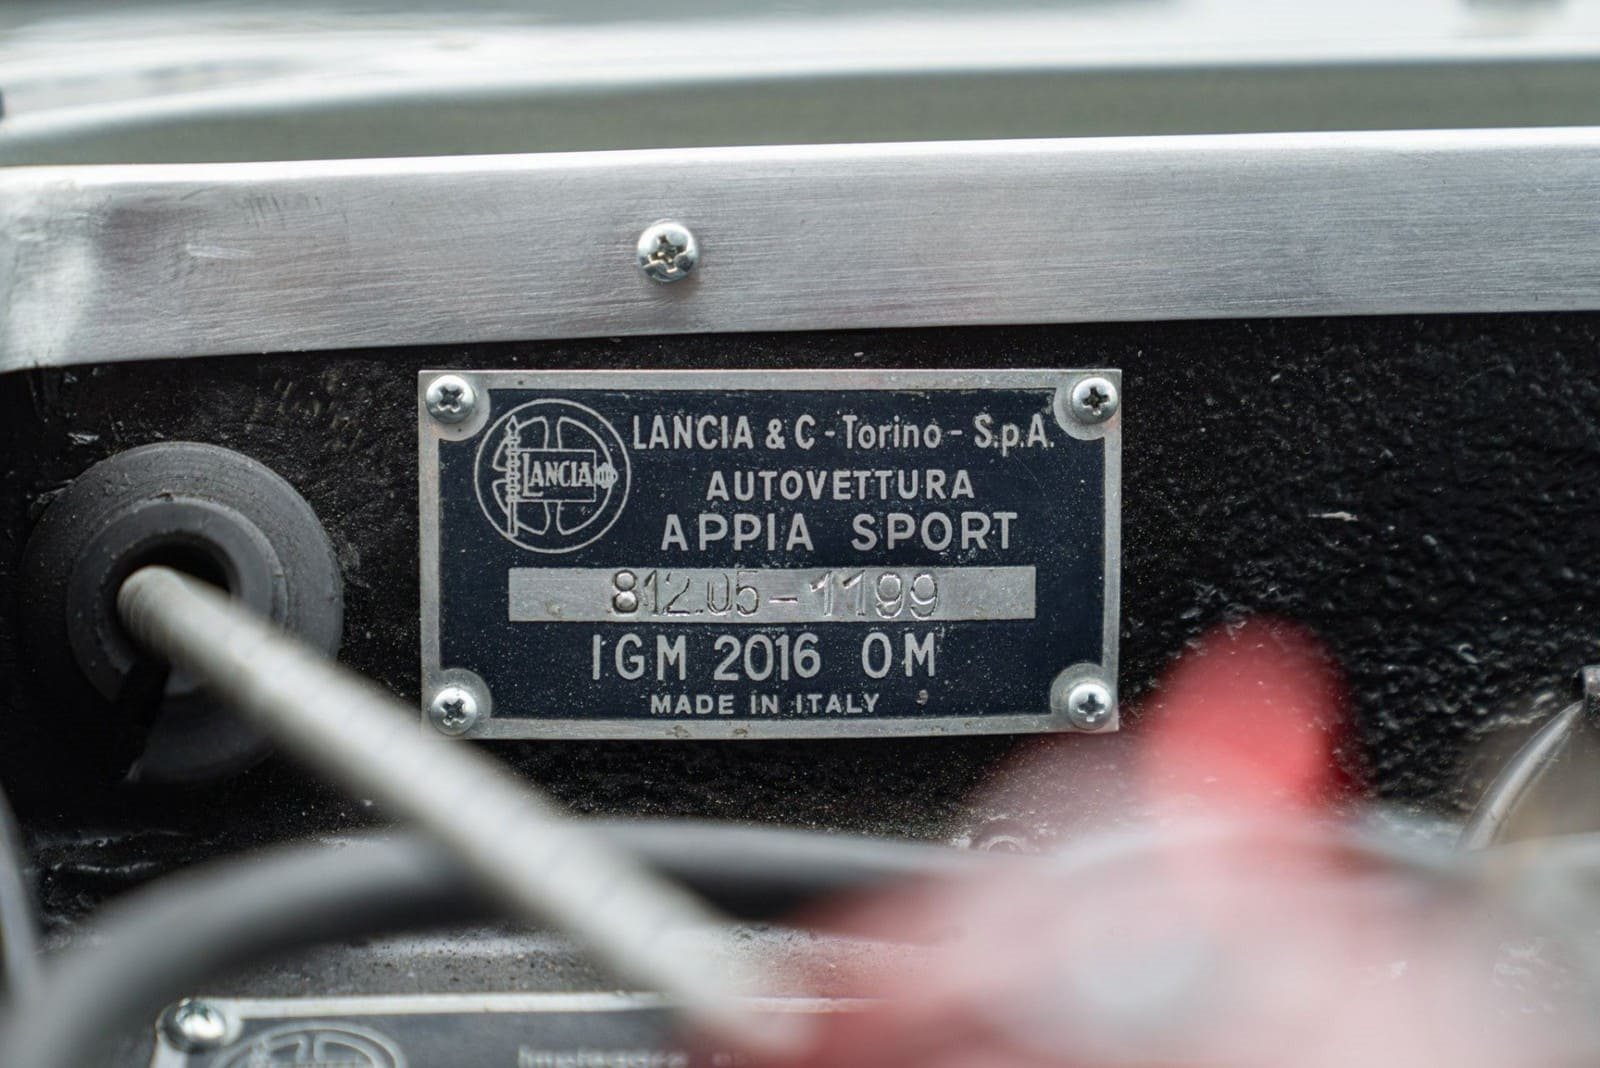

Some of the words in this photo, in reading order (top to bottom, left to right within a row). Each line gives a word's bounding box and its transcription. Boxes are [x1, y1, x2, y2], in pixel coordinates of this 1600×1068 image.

[632, 413, 755, 451] LANCIA
[765, 418, 786, 450] &
[794, 413, 816, 450] C
[522, 453, 594, 497] LANCIA
[706, 468, 976, 502] AUTOVETTURA
[661, 512, 815, 553] APPIA
[851, 510, 1018, 552] SPORT
[591, 634, 688, 682] IGM
[713, 633, 821, 681] 2016
[650, 693, 735, 715] MADE
[750, 693, 784, 714] IN
[795, 692, 880, 714] ITALY
